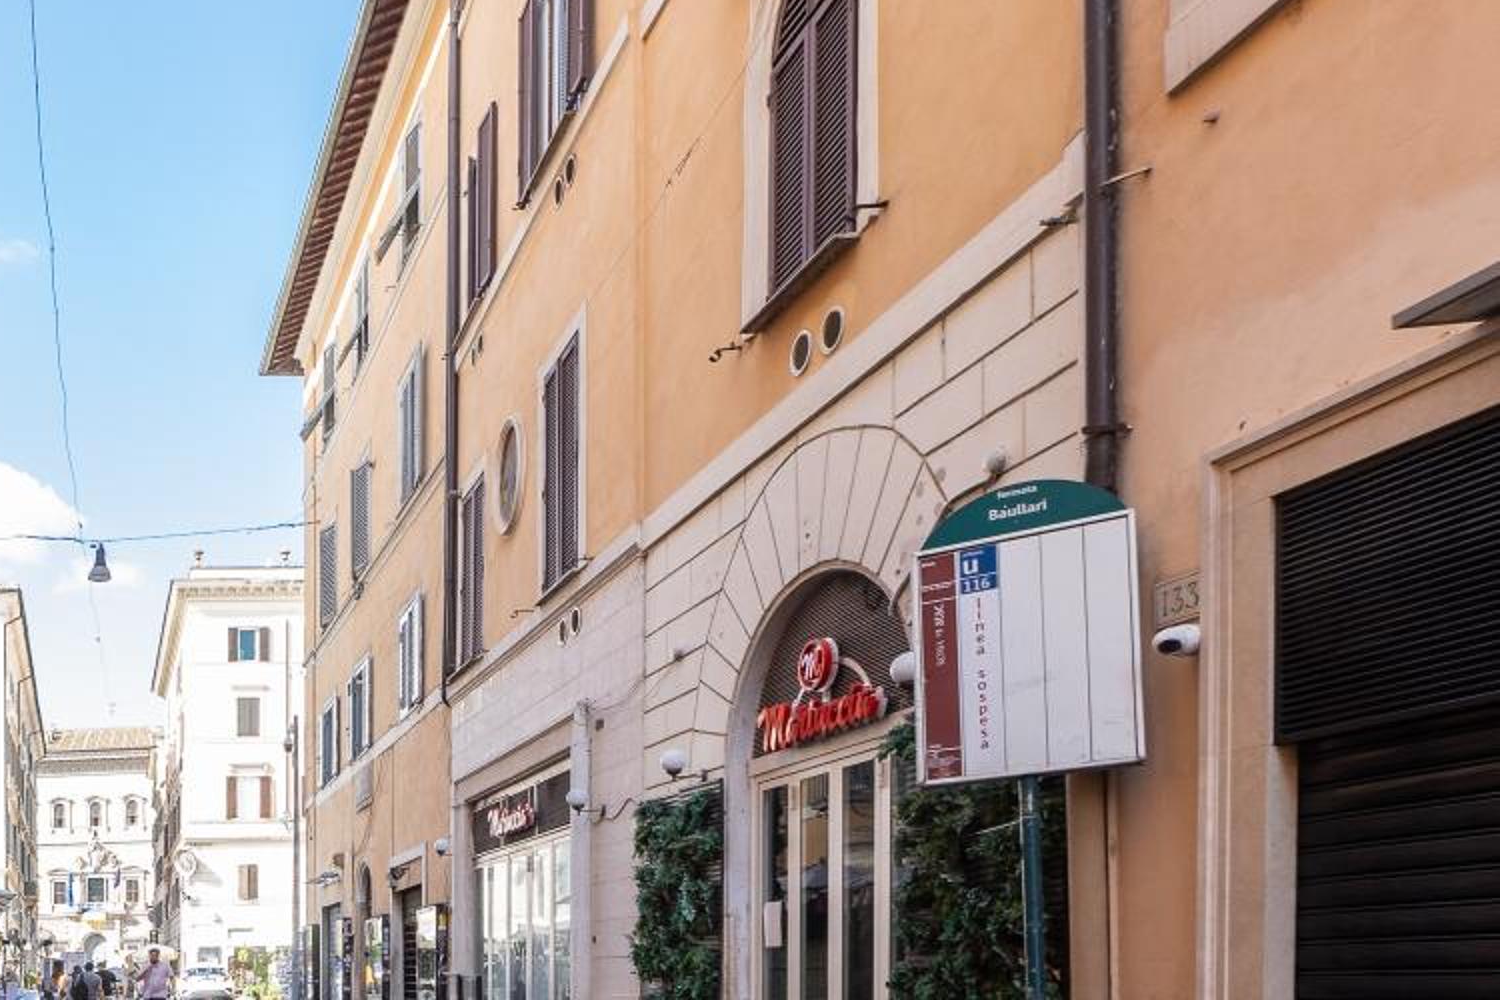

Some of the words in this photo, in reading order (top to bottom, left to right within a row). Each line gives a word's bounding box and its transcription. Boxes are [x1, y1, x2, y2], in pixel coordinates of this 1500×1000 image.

[988, 499, 1048, 521] Baullari
[963, 578, 991, 592] 116
[1162, 581, 1200, 616] 133
[977, 669, 990, 750] sospesa
